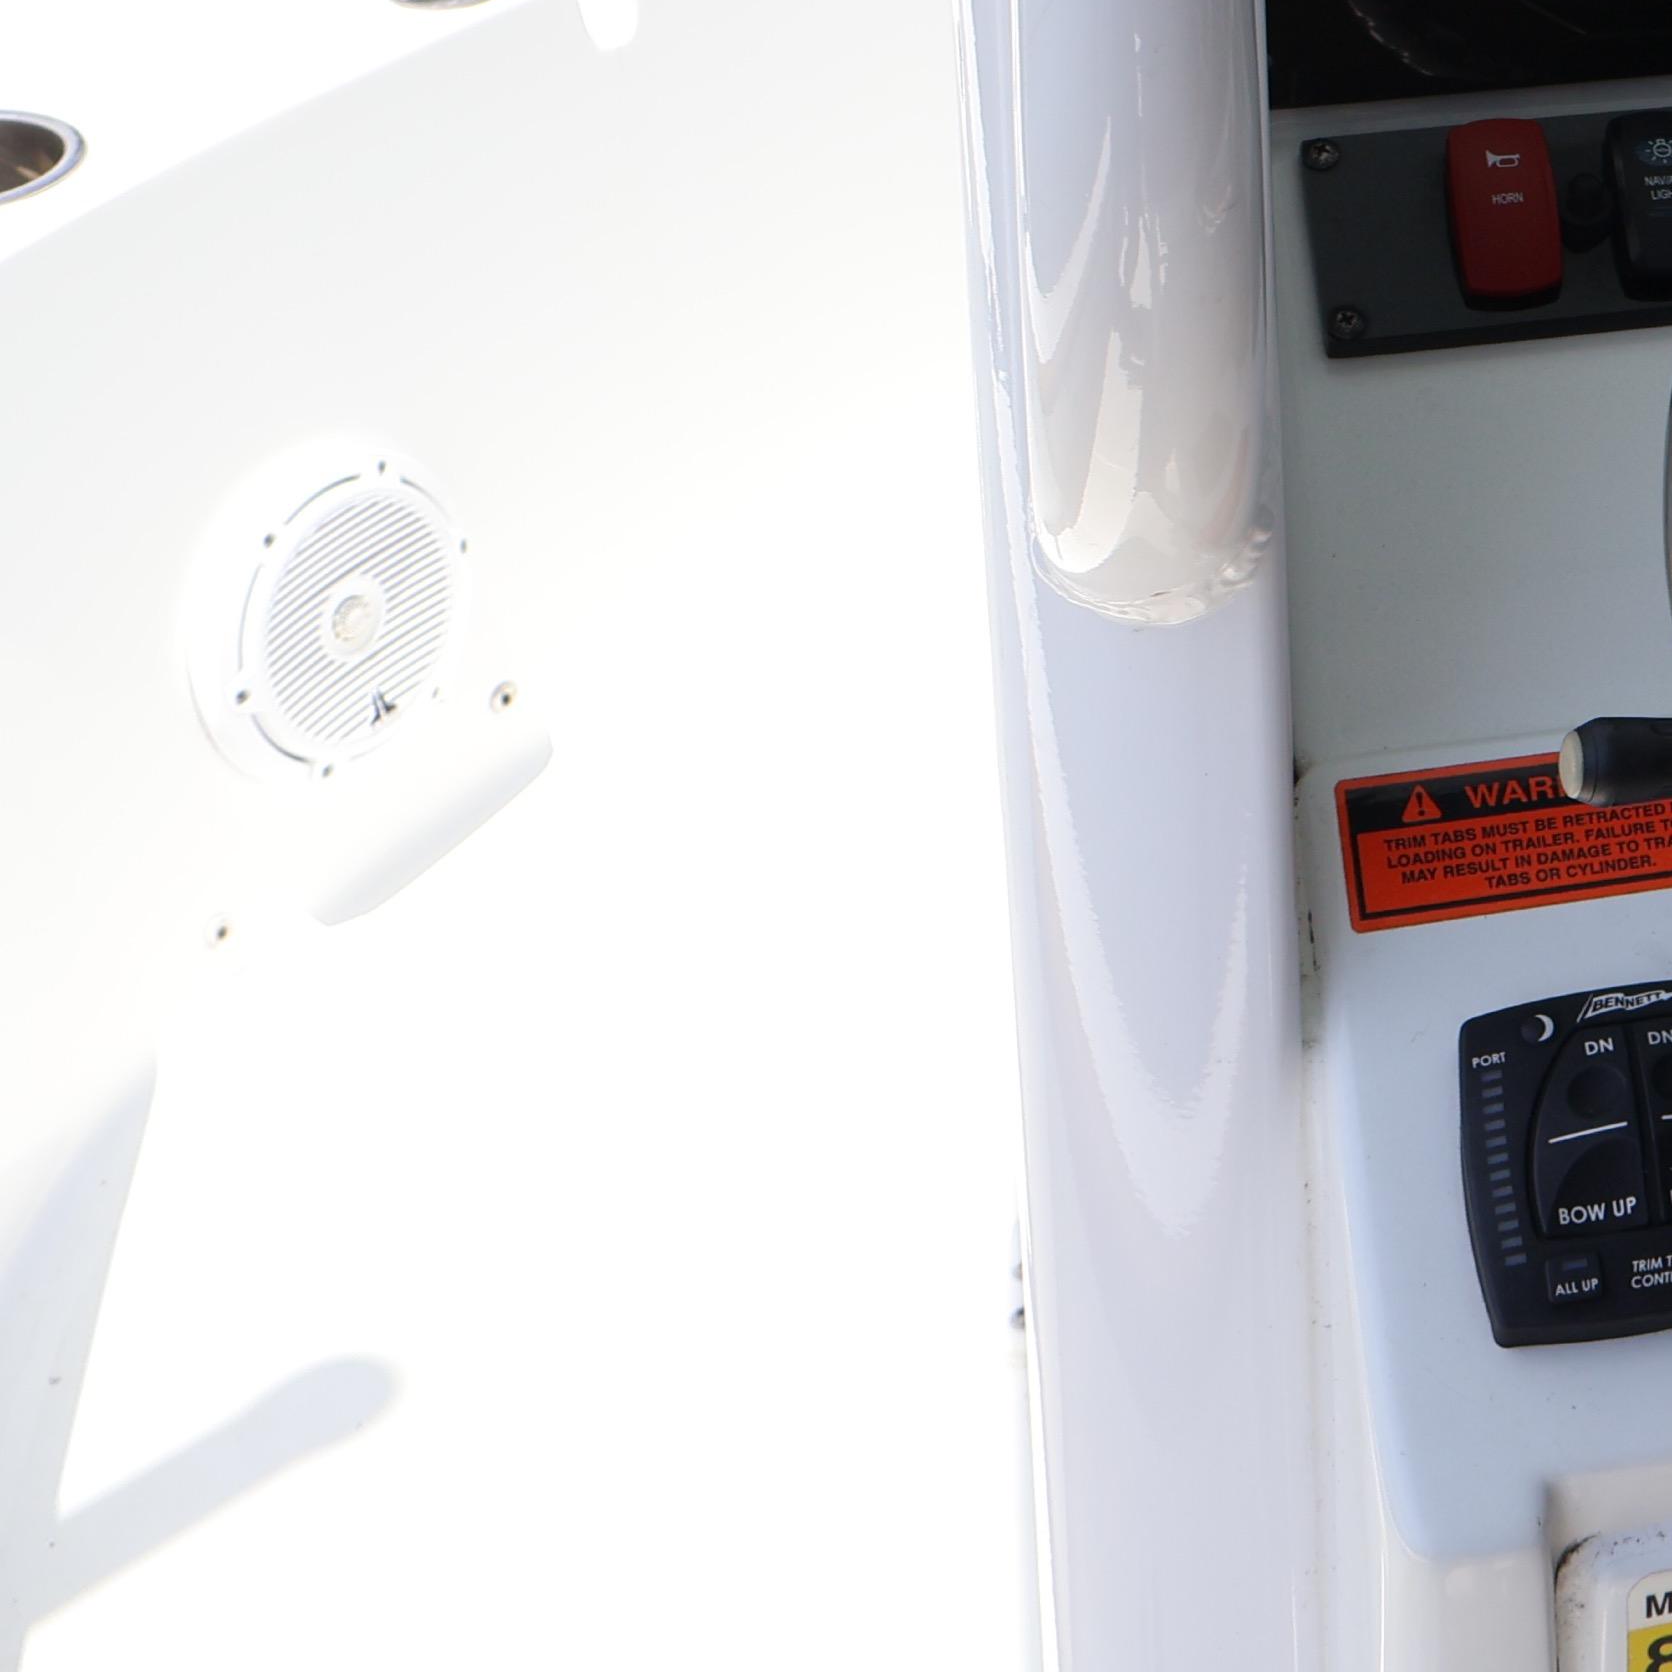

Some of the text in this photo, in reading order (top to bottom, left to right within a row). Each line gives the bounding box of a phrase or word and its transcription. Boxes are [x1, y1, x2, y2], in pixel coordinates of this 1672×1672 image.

[1492, 192, 1524, 205] HORN
[1384, 834, 1426, 852] TRIM
[1431, 829, 1477, 845] TABS
[1482, 821, 1530, 838] MUST
[1534, 816, 1557, 831] BE
[1562, 804, 1666, 827] RETRACTED
[1387, 847, 1466, 869] LOADING
[1471, 843, 1496, 857] ON
[1502, 830, 1580, 853] TRAILER.
[1584, 821, 1655, 842] FAILURE
[1402, 867, 1437, 884] MAY
[1443, 857, 1509, 878] RESULT
[1515, 853, 1531, 868] IN
[1537, 843, 1612, 866] DAMAGE
[1616, 840, 1639, 854] TO
[1484, 854, 1656, 889] TABS OR CYLINDER.
[1592, 991, 1667, 1011] BENNETT
[1584, 1037, 1614, 1056] DN
[1471, 1052, 1507, 1068] PORT
[1559, 1196, 1636, 1225] BOW UP
[1631, 1255, 1663, 1273] TRIM
[1555, 1277, 1599, 1296] ALL UP
